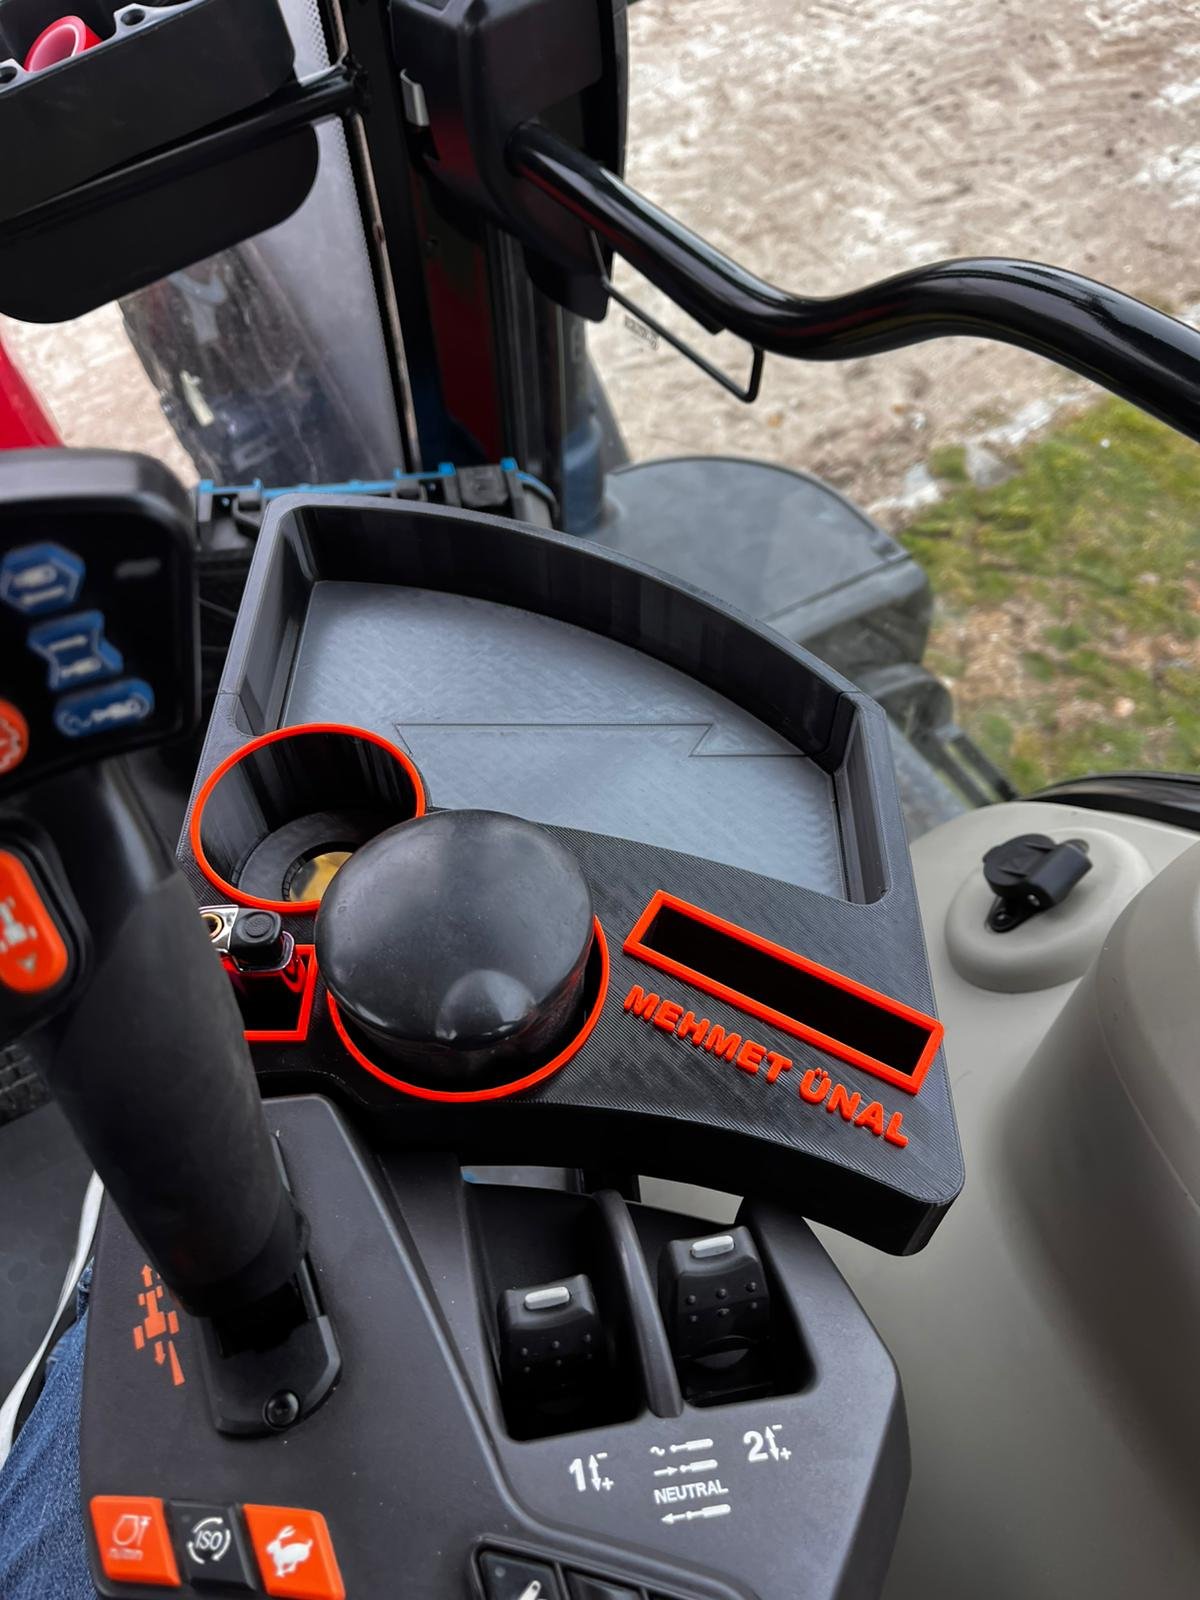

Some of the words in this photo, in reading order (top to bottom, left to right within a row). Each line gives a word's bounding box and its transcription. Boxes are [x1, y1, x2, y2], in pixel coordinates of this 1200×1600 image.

[623, 984, 793, 1084] MEHMET
[800, 1067, 909, 1148] ÜNAL
[743, 1430, 769, 1462] 2
[568, 1458, 587, 1492] 1
[653, 1479, 729, 1504] NEUTRAL
[195, 1530, 223, 1550] ISO
